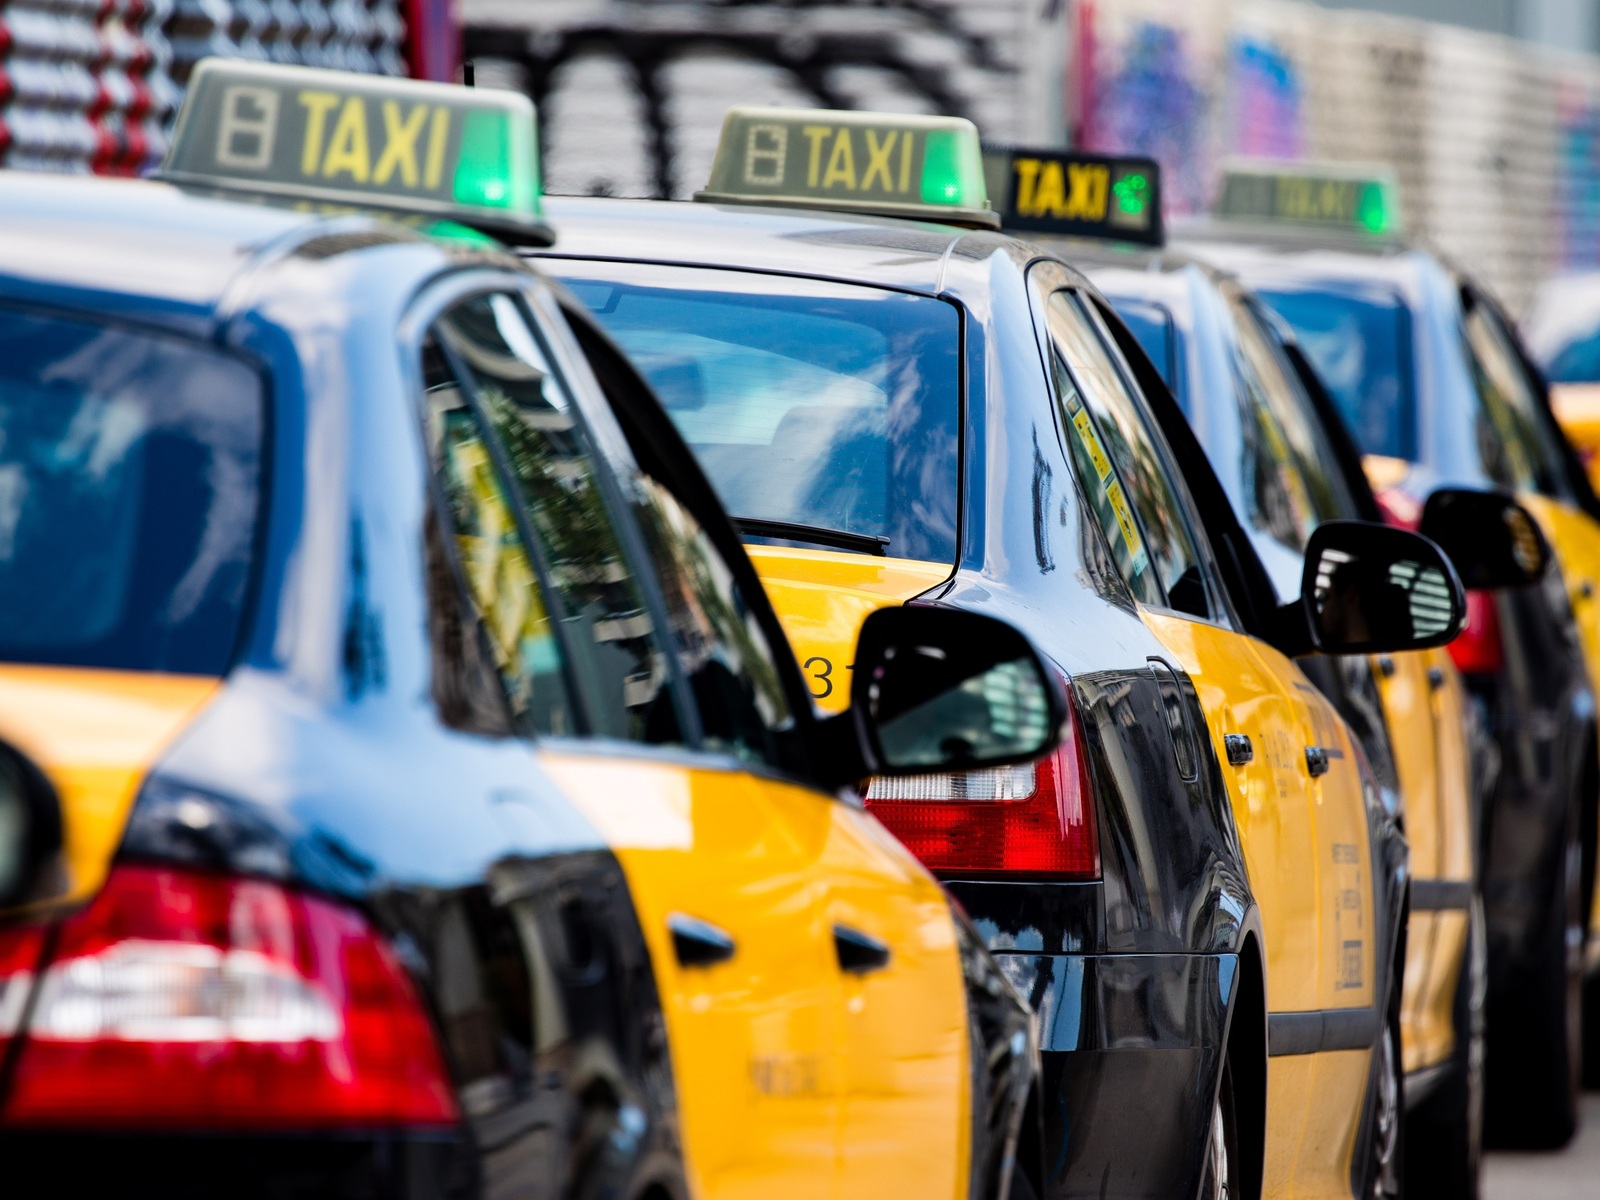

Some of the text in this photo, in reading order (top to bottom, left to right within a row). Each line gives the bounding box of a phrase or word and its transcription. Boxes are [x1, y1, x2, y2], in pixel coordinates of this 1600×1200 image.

[299, 90, 450, 190] TAXI
[803, 125, 914, 193] TAXI
[1014, 158, 1110, 222] TAXI
